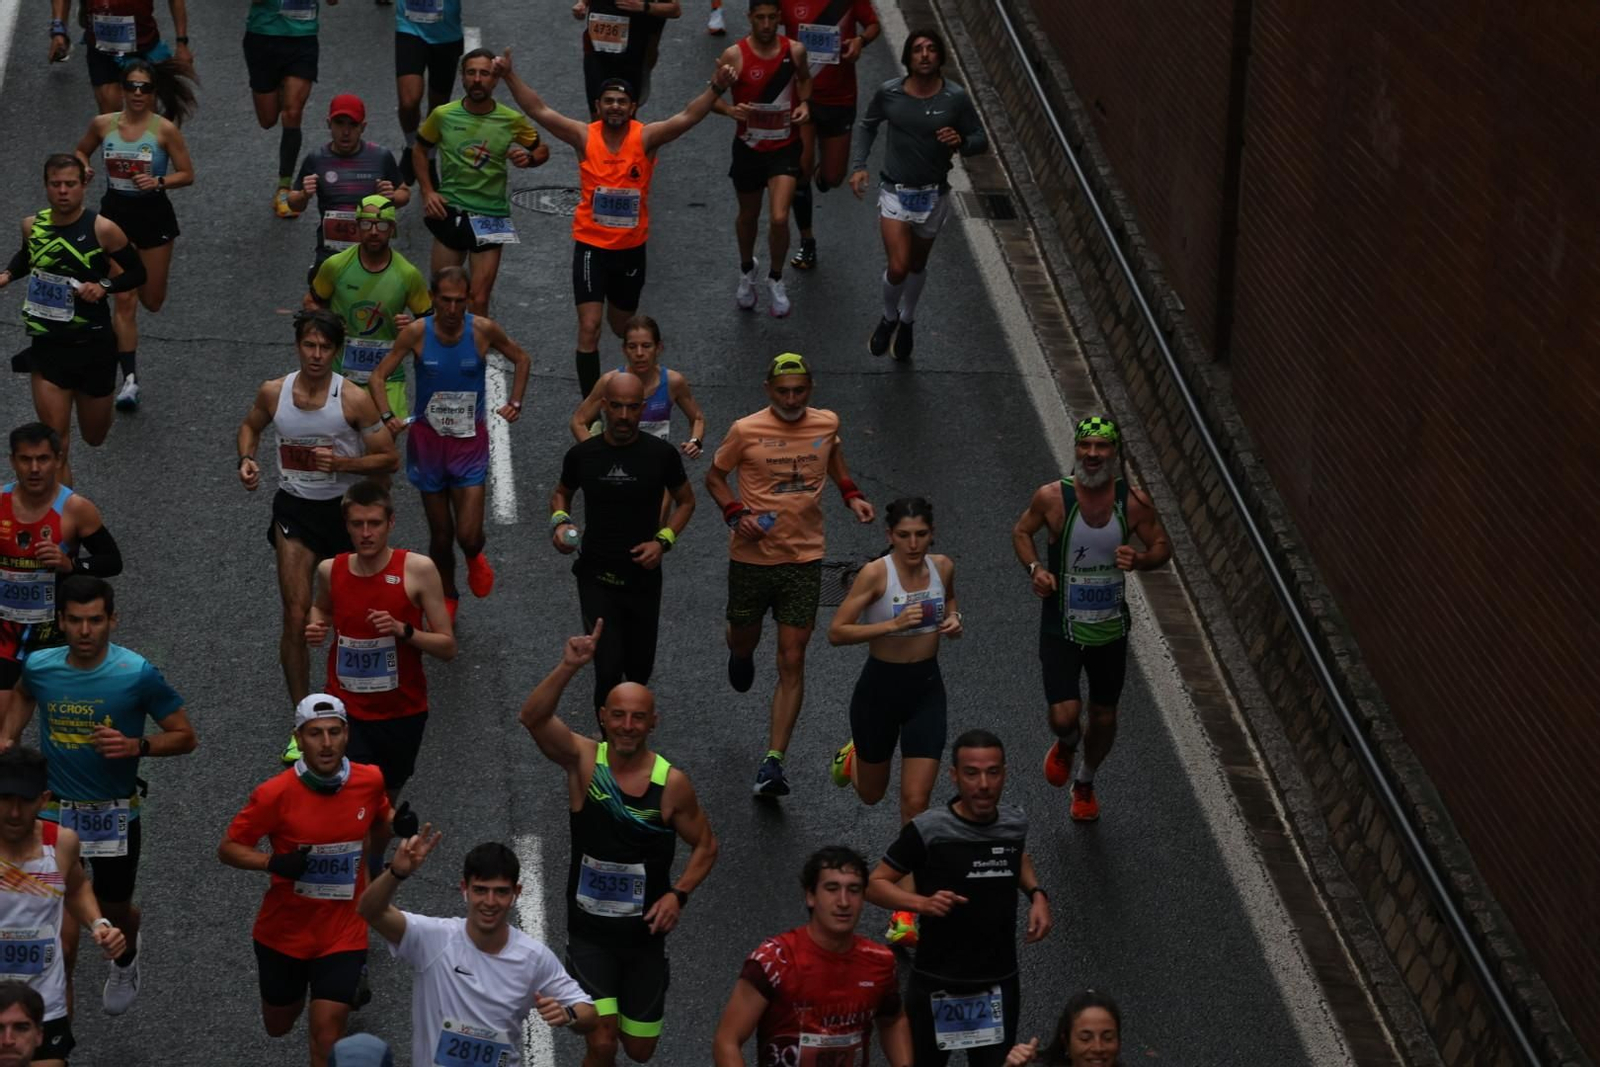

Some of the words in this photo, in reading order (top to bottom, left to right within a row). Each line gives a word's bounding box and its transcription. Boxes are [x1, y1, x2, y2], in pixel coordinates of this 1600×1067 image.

[593, 23, 619, 36] 4736
[33, 282, 63, 300] 2143
[430, 404, 465, 415] Emeterio
[4, 584, 40, 601] 2996
[1077, 587, 1112, 602] 3003
[345, 652, 381, 669] 2197
[59, 703, 95, 715] CROSS
[71, 813, 114, 832] 1586
[306, 856, 350, 875] 2064
[588, 872, 629, 893] 2535
[0, 943, 41, 963] 996
[943, 1000, 987, 1022] 2072
[447, 1037, 495, 1065] 2818
